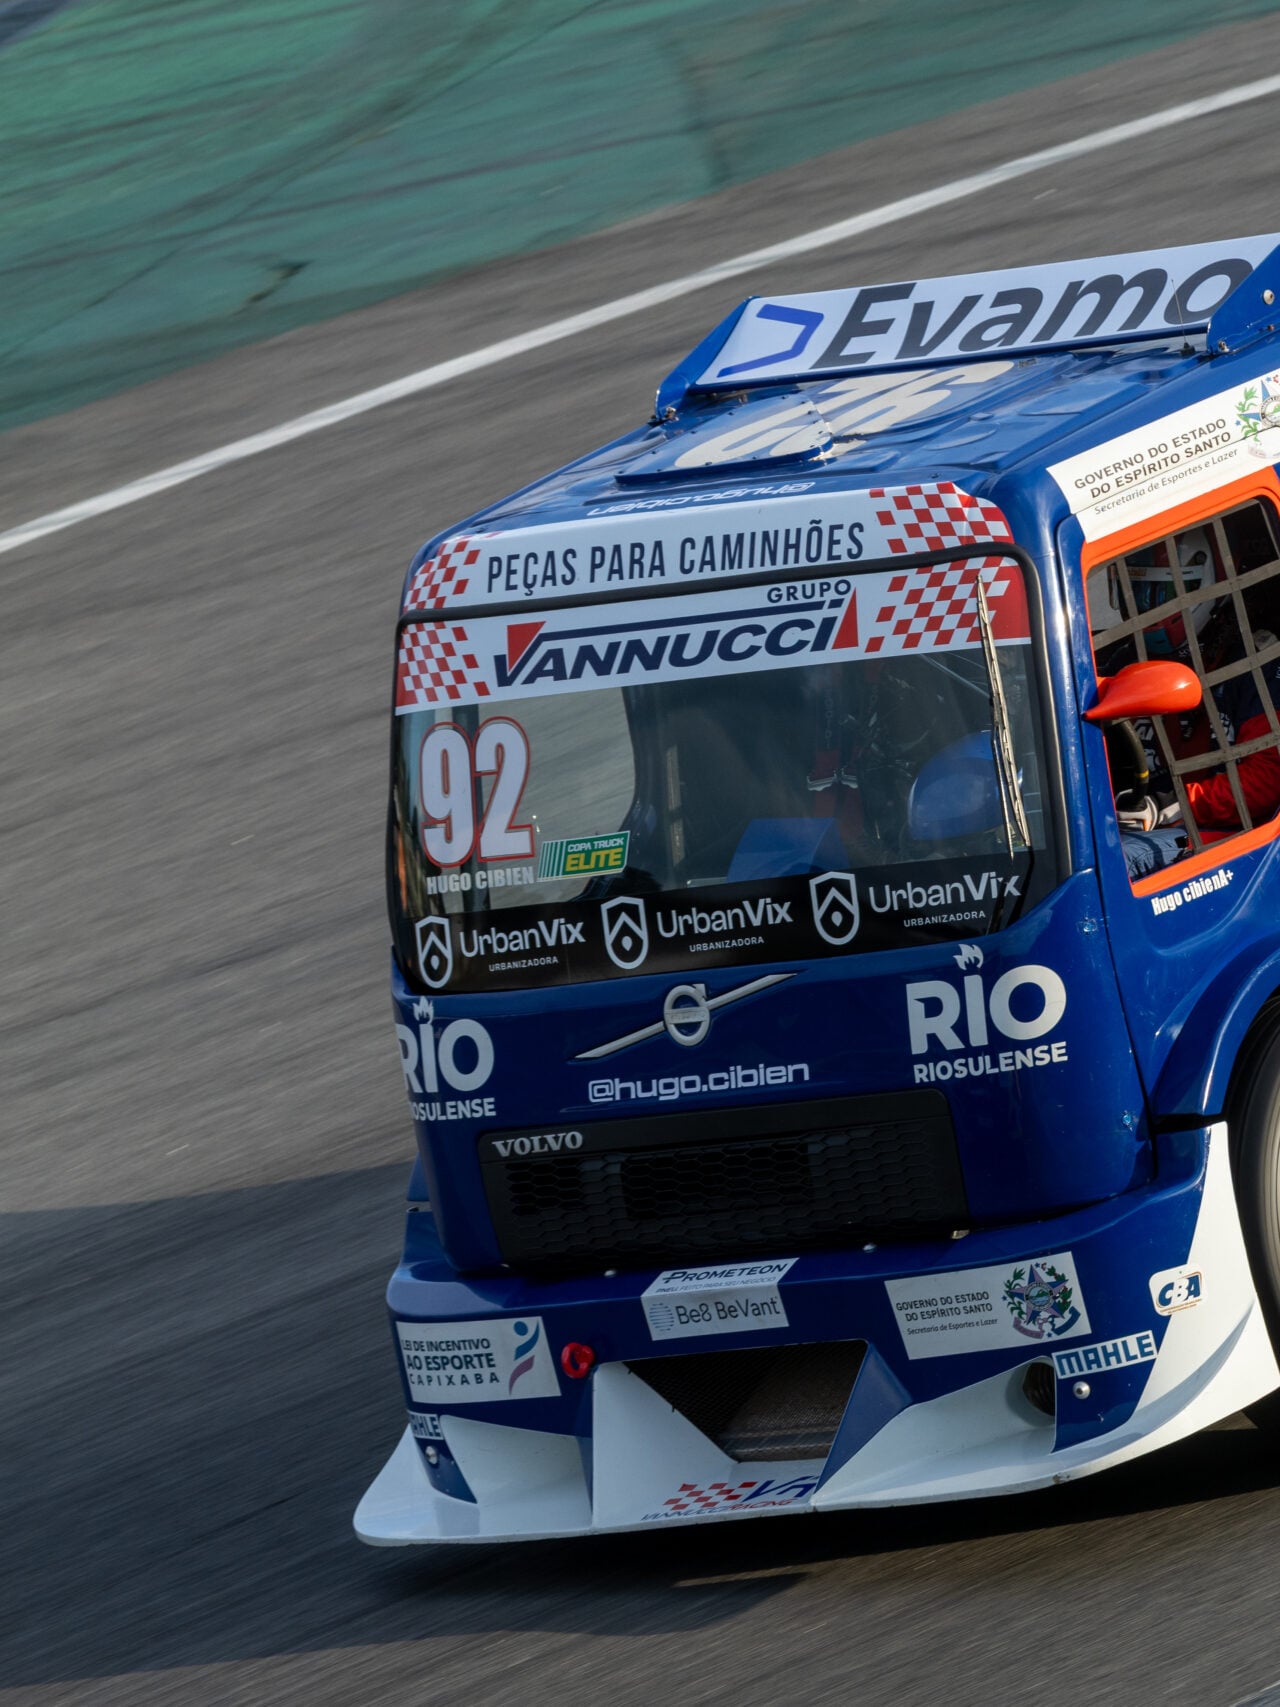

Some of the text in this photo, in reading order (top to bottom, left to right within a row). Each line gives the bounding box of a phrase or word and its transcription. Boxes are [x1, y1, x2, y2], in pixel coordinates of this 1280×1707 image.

[809, 257, 1255, 370] Evamo
[1074, 418, 1226, 490] GOVERNO DO ESTADO
[1090, 481, 1111, 499] DO
[1115, 453, 1181, 490] ESPÍRITO
[1185, 431, 1231, 459] SANTO
[1094, 487, 1146, 515] Secretaria
[1147, 481, 1160, 494] de
[1161, 464, 1203, 488] Esportes
[1204, 459, 1211, 469] e
[1212, 447, 1239, 466] Lazer
[487, 519, 865, 597] PEÇAS PARA CAMINHÕES
[767, 579, 852, 605] GRUPO
[493, 598, 848, 688] VANNUCCI
[420, 716, 535, 868] 92
[567, 837, 624, 853] COPA TRUCK
[565, 848, 623, 872] ELITE
[426, 866, 534, 895] HUGO CIBIEN
[869, 871, 1022, 913] UrbanVix
[1151, 891, 1183, 916] Hugo
[656, 897, 794, 939] UrbanVix
[903, 910, 986, 928] URBANIZADORA
[460, 917, 586, 958] UrbanVix
[689, 936, 765, 953] URBANIZADORA
[489, 956, 559, 972] URBANIZADORA
[906, 964, 1067, 1055] RIO
[913, 1041, 1069, 1083] RIOSULENSE
[588, 1063, 809, 1102] @hugo.cibien
[409, 1097, 497, 1121] OSULENSE
[492, 1131, 584, 1157] VOLVO
[662, 1263, 788, 1284] PROMETEON
[896, 1291, 990, 1311] GOVERNO DO ESTADO
[1158, 1274, 1201, 1307] CBA
[675, 1298, 781, 1325] Be8 BeVant
[905, 1303, 993, 1322] DO ESPÍRITO SANTO
[907, 1325, 939, 1336] Secretaria
[948, 1320, 975, 1331] Esportes
[981, 1318, 998, 1326] Lazer
[401, 1338, 490, 1352] LEI DE INCENTIVO
[1055, 1334, 1154, 1377] MAHLE
[406, 1352, 496, 1371] AO ESPORTE
[410, 1372, 499, 1386] CAPIXABA
[410, 1414, 441, 1437] AHLE
